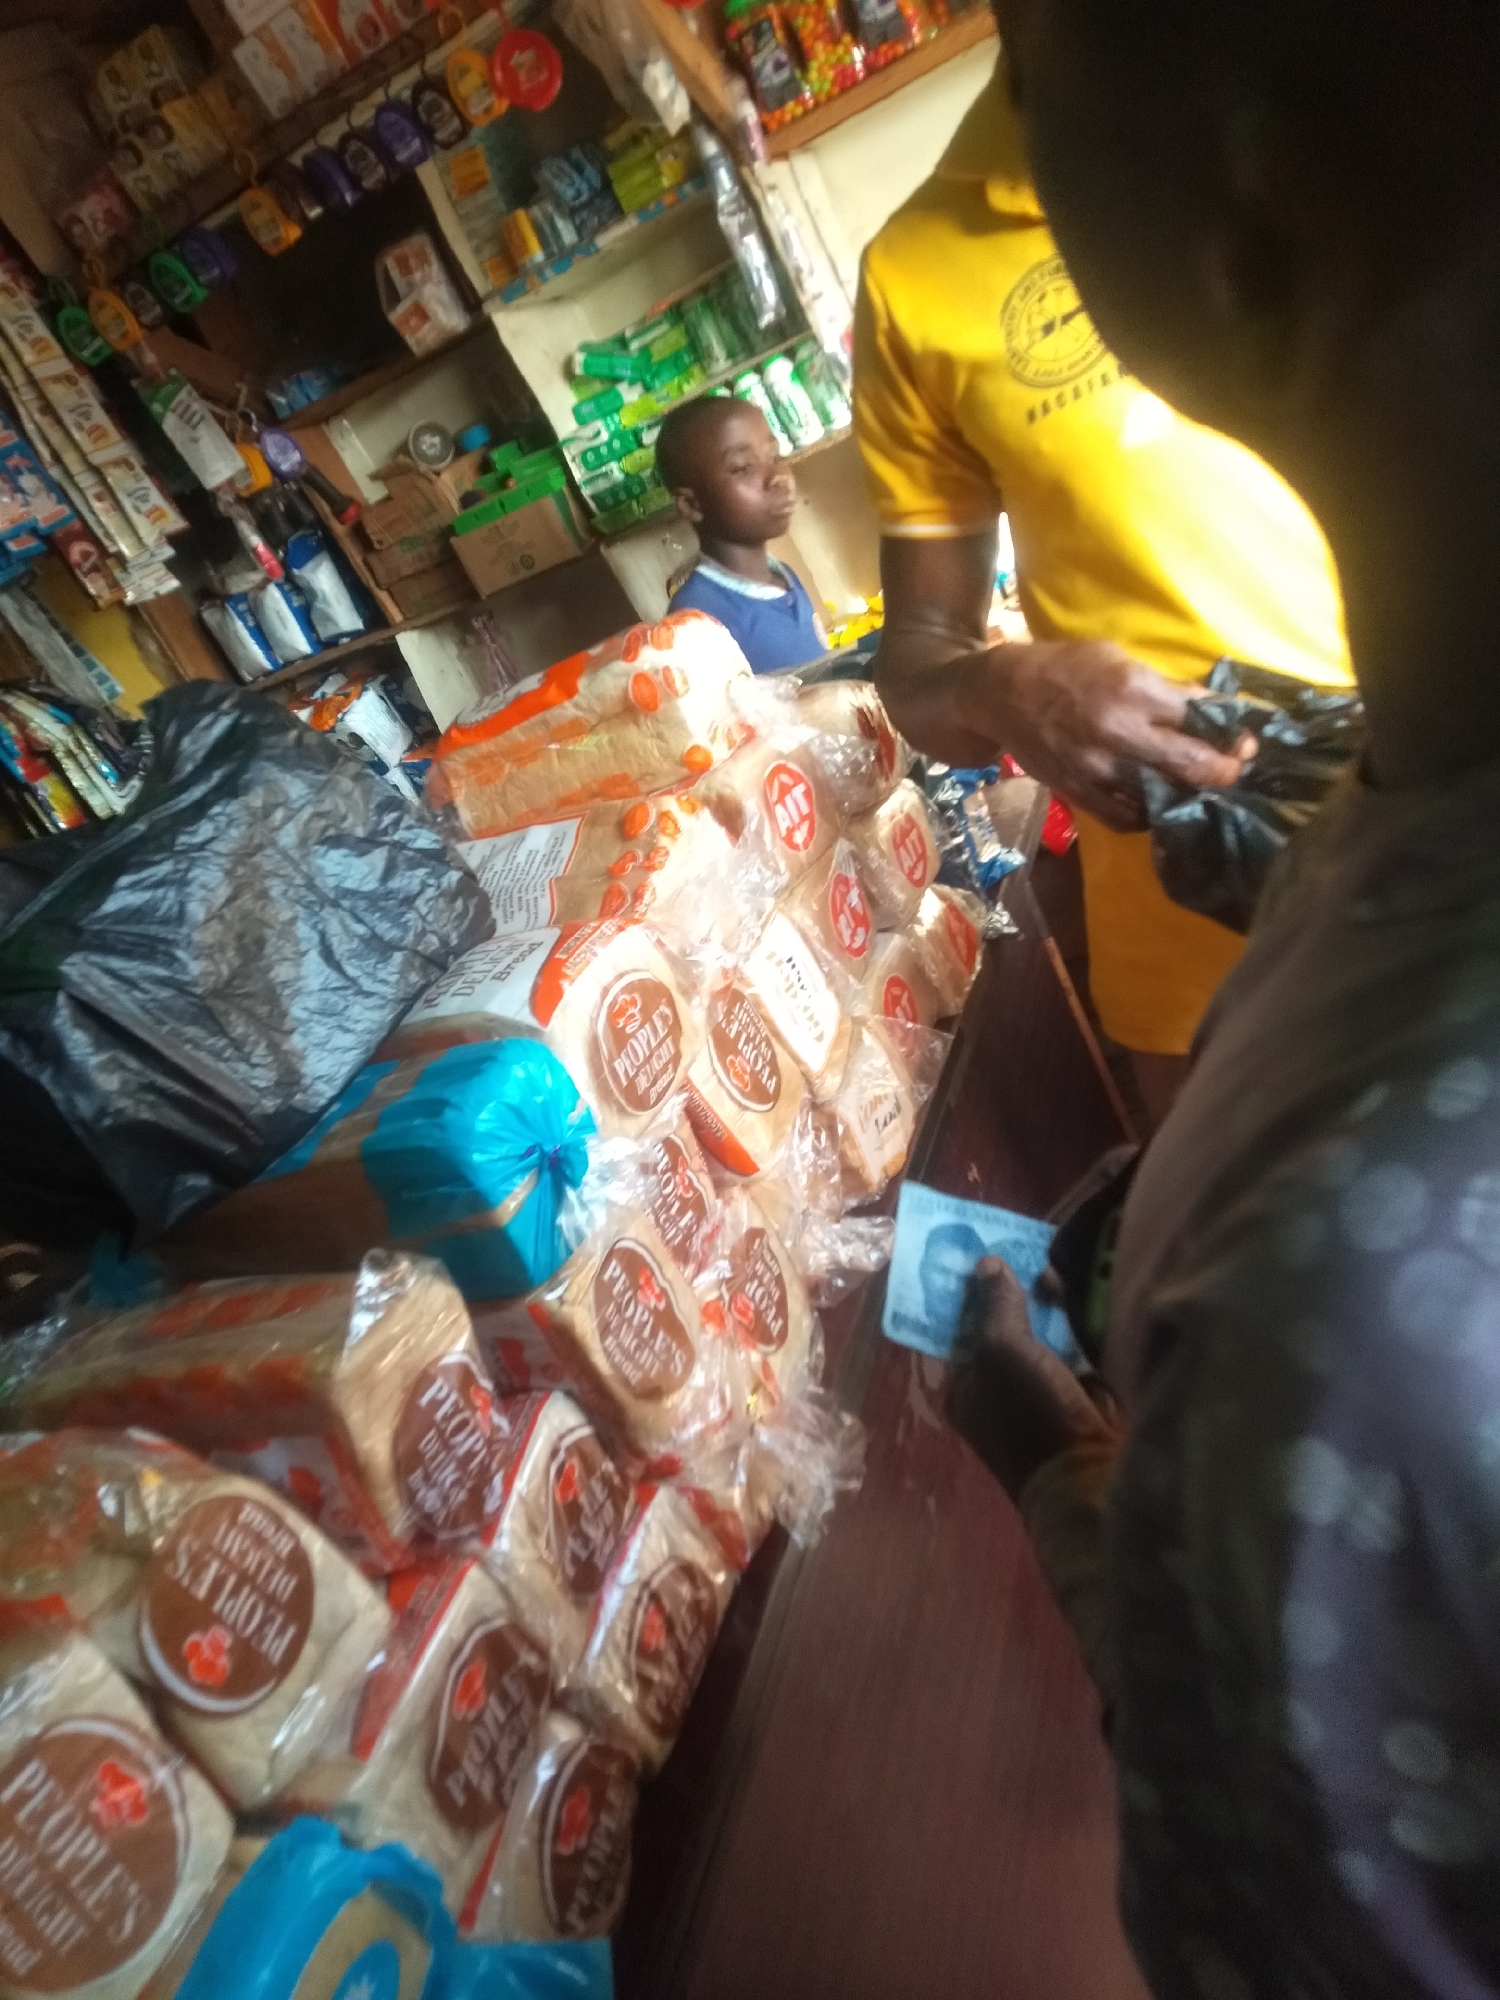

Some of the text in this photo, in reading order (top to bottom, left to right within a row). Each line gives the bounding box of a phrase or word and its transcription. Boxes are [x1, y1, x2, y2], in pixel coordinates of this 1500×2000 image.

[774, 782, 810, 838] AIT
[897, 828, 923, 875] AIT
[490, 941, 544, 982] Bread
[765, 950, 825, 1044] Goden
[613, 997, 674, 1089] PEOPLE'S
[634, 1036, 676, 1096] DELIGHT
[717, 1001, 778, 1095] PEOPLE'S
[654, 1141, 697, 1248] PEOPLE'
[603, 1258, 686, 1377] PEOPLE'S
[165, 1535, 298, 1666] PEOPLE'S
[212, 1519, 299, 1605] DELIGHT
[0, 1758, 146, 1946] PEOPLE'S
